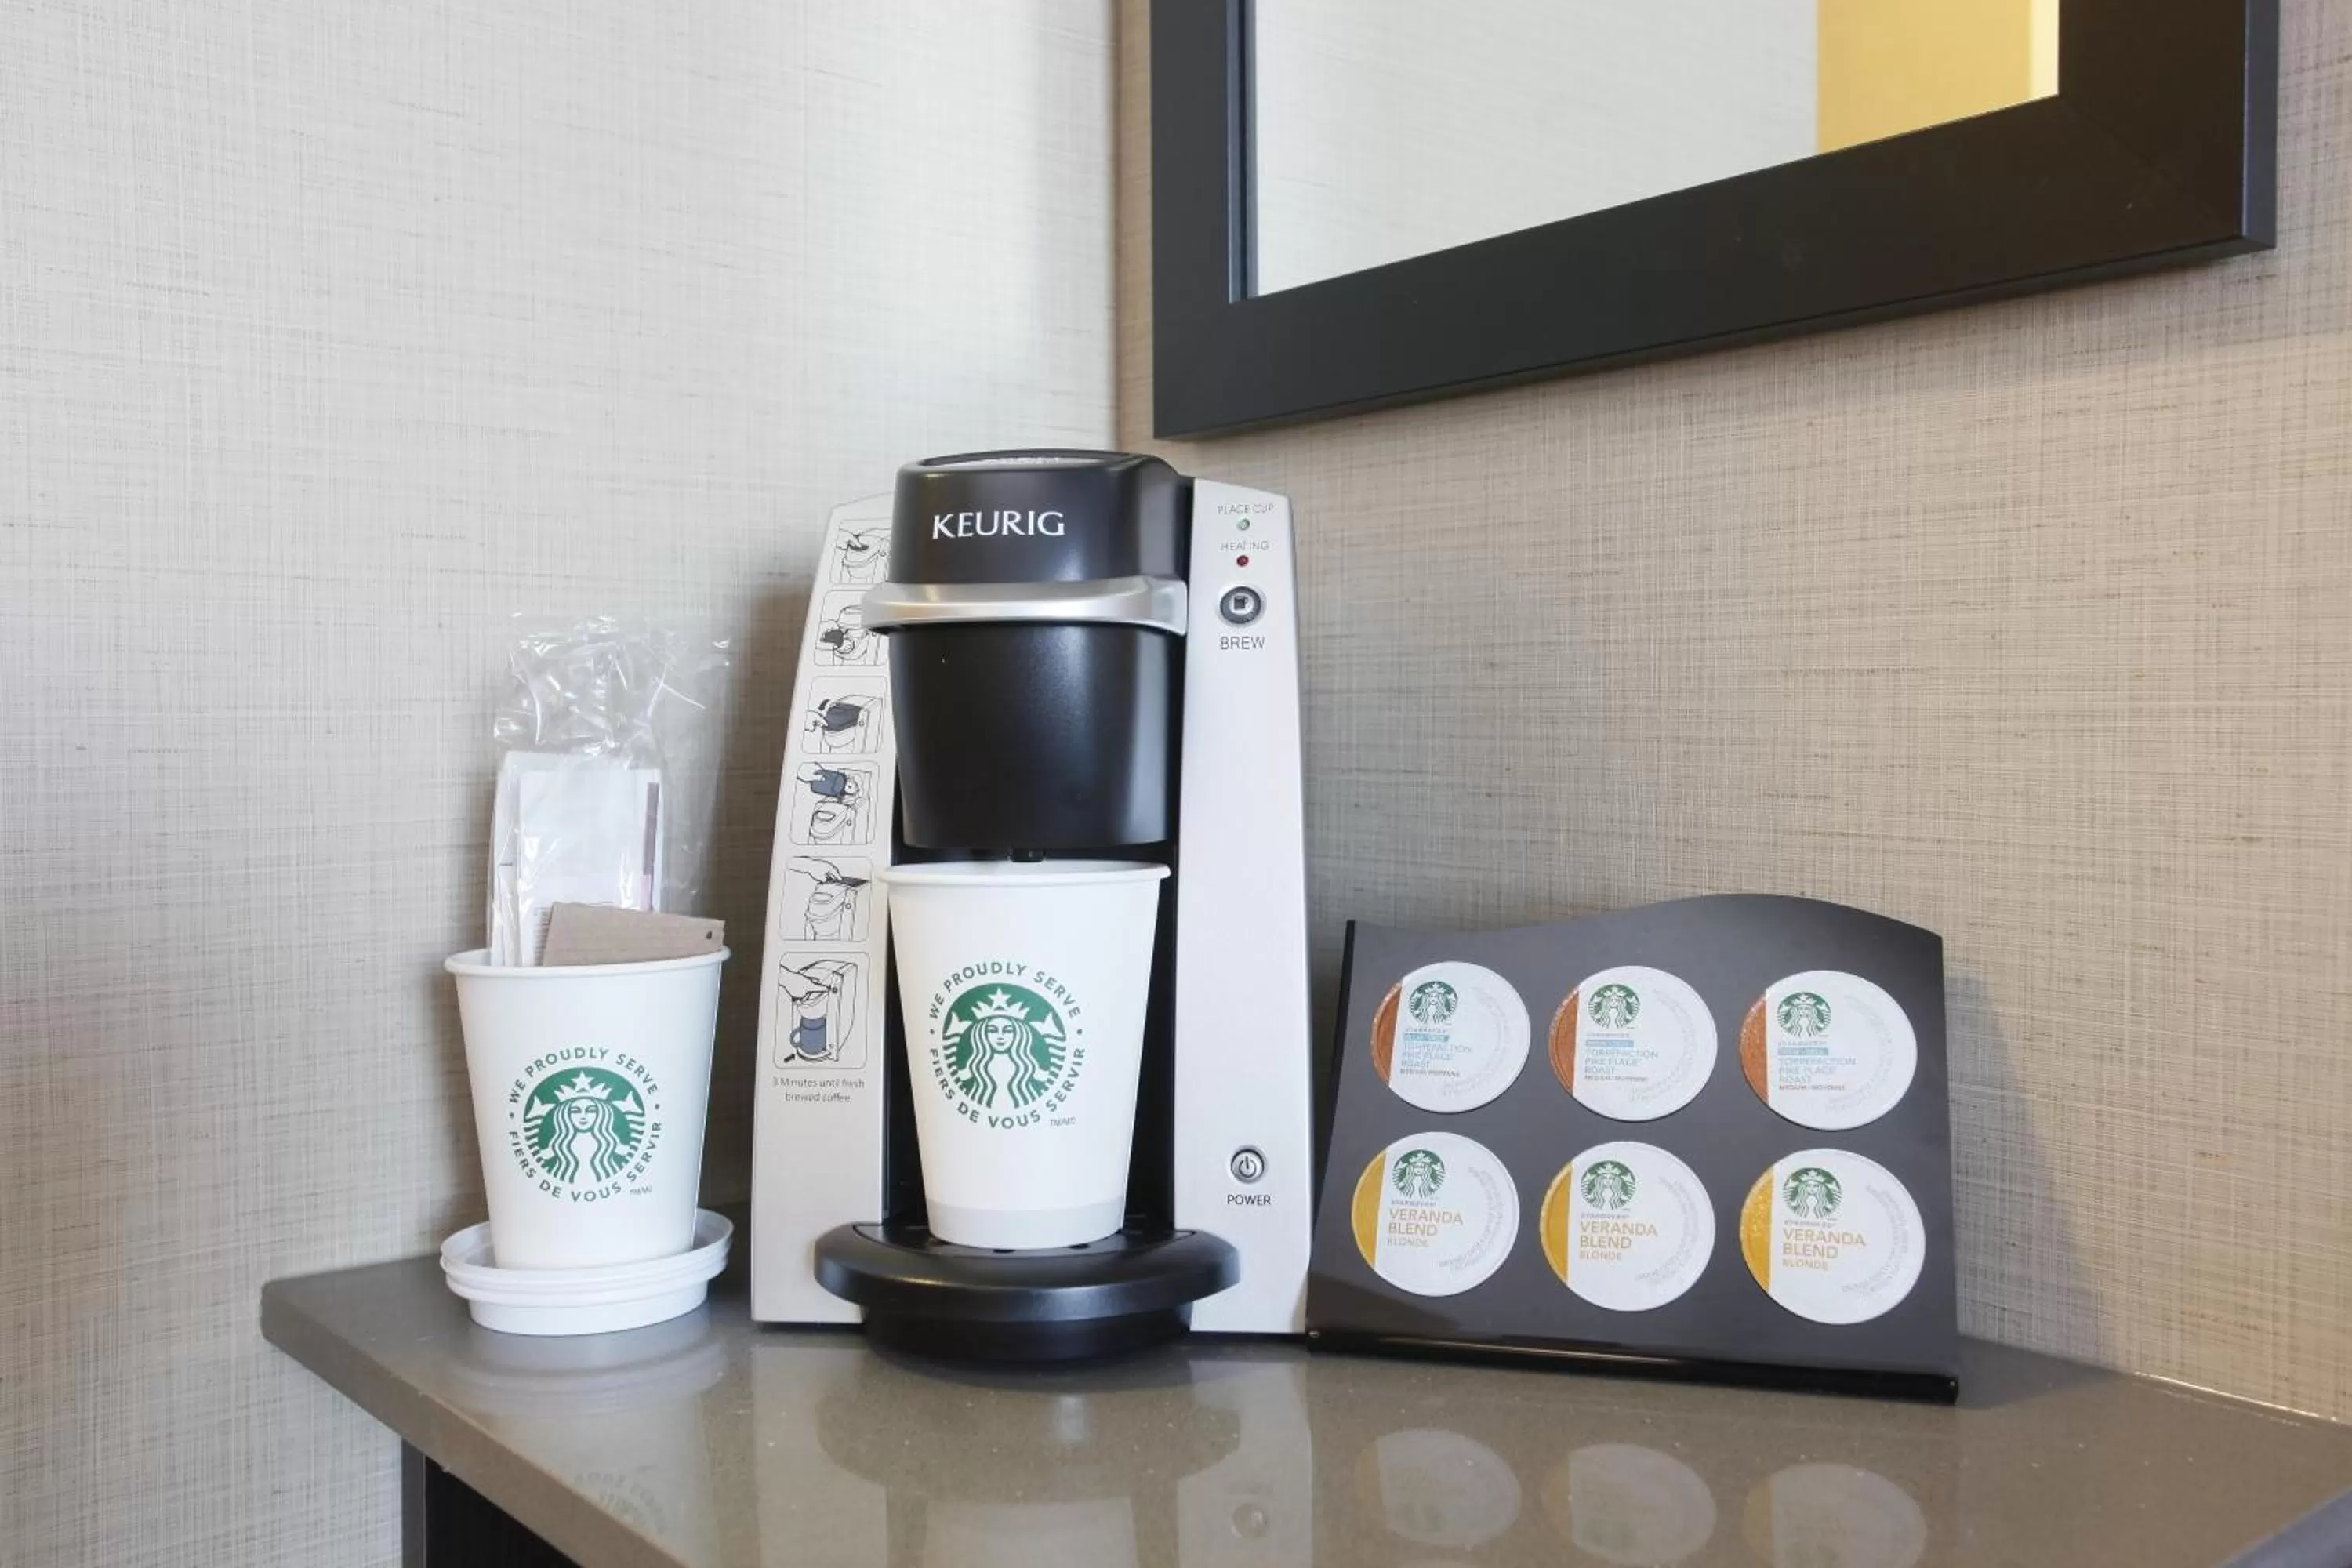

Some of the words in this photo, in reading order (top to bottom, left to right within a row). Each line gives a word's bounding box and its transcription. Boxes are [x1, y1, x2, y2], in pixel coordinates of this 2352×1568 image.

[1218, 504, 1249, 514] PLACE
[1252, 503, 1274, 514] CUP
[932, 510, 1065, 540] KEURIG
[1220, 541, 1270, 550] HEATING
[1220, 636, 1265, 650] BREW
[930, 993, 945, 1019] WE
[943, 962, 1028, 993] PROUDLY
[1034, 971, 1081, 1018] SERVE
[509, 1079, 526, 1103] WE
[524, 1047, 609, 1078] PROUDLY
[615, 1053, 658, 1095] SERVE
[780, 1078, 817, 1087] Minutes
[930, 1048, 955, 1100] FIERS
[957, 1102, 979, 1123] DE
[989, 1110, 1040, 1129] VOUS
[1046, 1047, 1085, 1112] SERVIR
[510, 1131, 537, 1178] FIERS
[539, 1179, 562, 1198] DE
[572, 1182, 621, 1203] VOUS
[626, 1121, 662, 1182] SERVIR
[1227, 1194, 1271, 1206] POWER
[1389, 1207, 1463, 1225] VERANDA
[1388, 1222, 1438, 1236] BLEND
[1580, 1221, 1658, 1237] VERANDA
[1580, 1235, 1632, 1249] BLEND
[1783, 1228, 1866, 1247] VERANDA
[1783, 1243, 1838, 1259] BLEND
